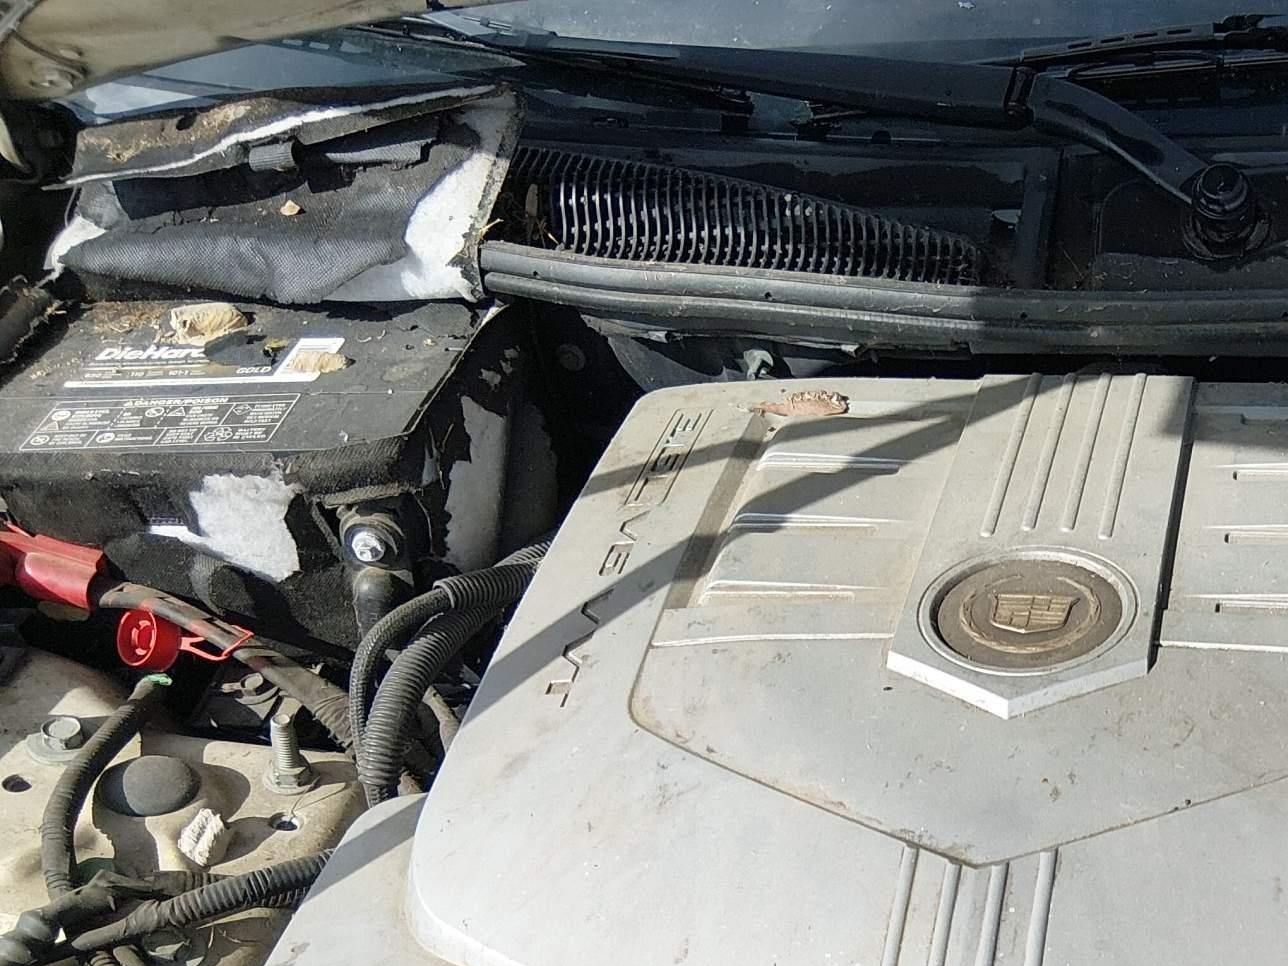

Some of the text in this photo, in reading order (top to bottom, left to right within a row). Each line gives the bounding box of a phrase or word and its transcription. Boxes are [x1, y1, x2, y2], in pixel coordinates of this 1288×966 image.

[236, 366, 272, 374] GOLD
[545, 510, 651, 708] V6 VVT
